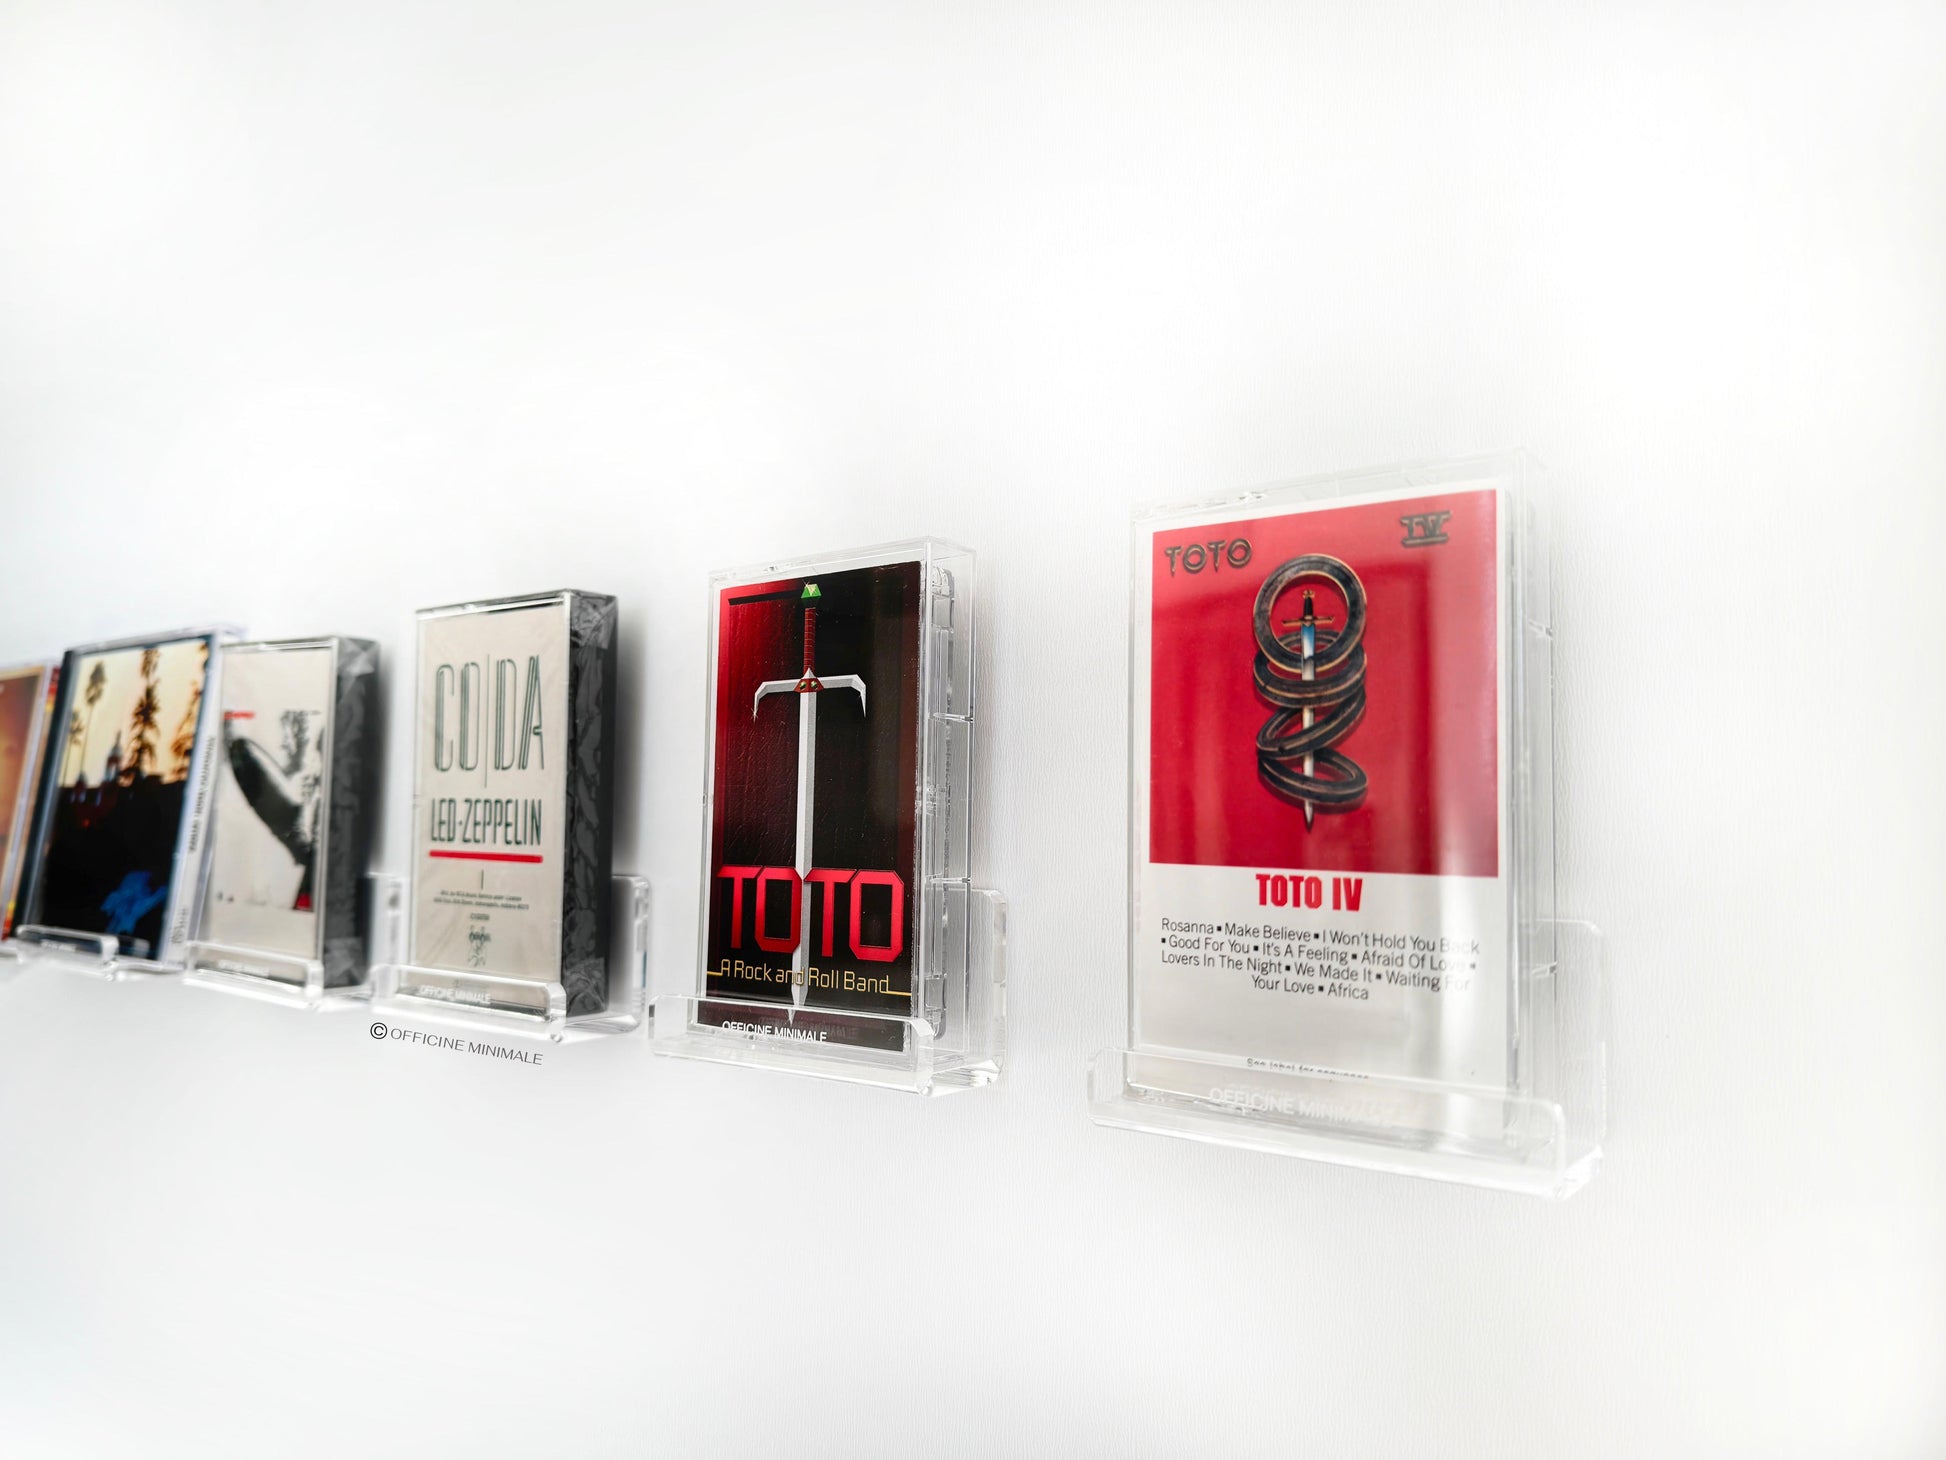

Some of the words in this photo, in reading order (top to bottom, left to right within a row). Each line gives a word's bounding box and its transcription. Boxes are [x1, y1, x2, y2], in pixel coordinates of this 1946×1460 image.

[1400, 511, 1451, 546] IV
[1165, 538, 1252, 577] TOTO
[1256, 873, 1323, 909] TOTO
[1332, 878, 1363, 911] IV
[716, 865, 905, 962] TOTO
[1161, 917, 1214, 934] Rosanna
[1225, 922, 1260, 938] Make
[1263, 925, 1311, 942] Believe
[1329, 930, 1369, 946] Won't
[1372, 934, 1406, 950] Hold
[1410, 936, 1436, 952] You
[1168, 934, 1200, 950] Good
[1204, 937, 1225, 952] For
[1228, 939, 1250, 954] You
[1262, 942, 1280, 957] It's
[1284, 944, 1294, 958] A
[1298, 945, 1348, 965] Feeling
[1361, 950, 1404, 968] Afraid
[1408, 953, 1426, 969] Of
[720, 959, 731, 977] A
[734, 960, 772, 982] Rock
[775, 964, 804, 986] and
[808, 967, 839, 989] Roll
[843, 971, 889, 994] Band
[1161, 950, 1200, 966] Lovers
[1204, 954, 1215, 967] In
[1219, 954, 1243, 970] The
[1247, 957, 1282, 976] Night
[1294, 961, 1315, 977] We
[1319, 964, 1358, 981] Made
[1363, 967, 1372, 983] It
[1386, 969, 1440, 992] Waiting
[1251, 974, 1280, 990] Your
[1283, 978, 1315, 994] Love
[1327, 982, 1369, 1000] Africa
